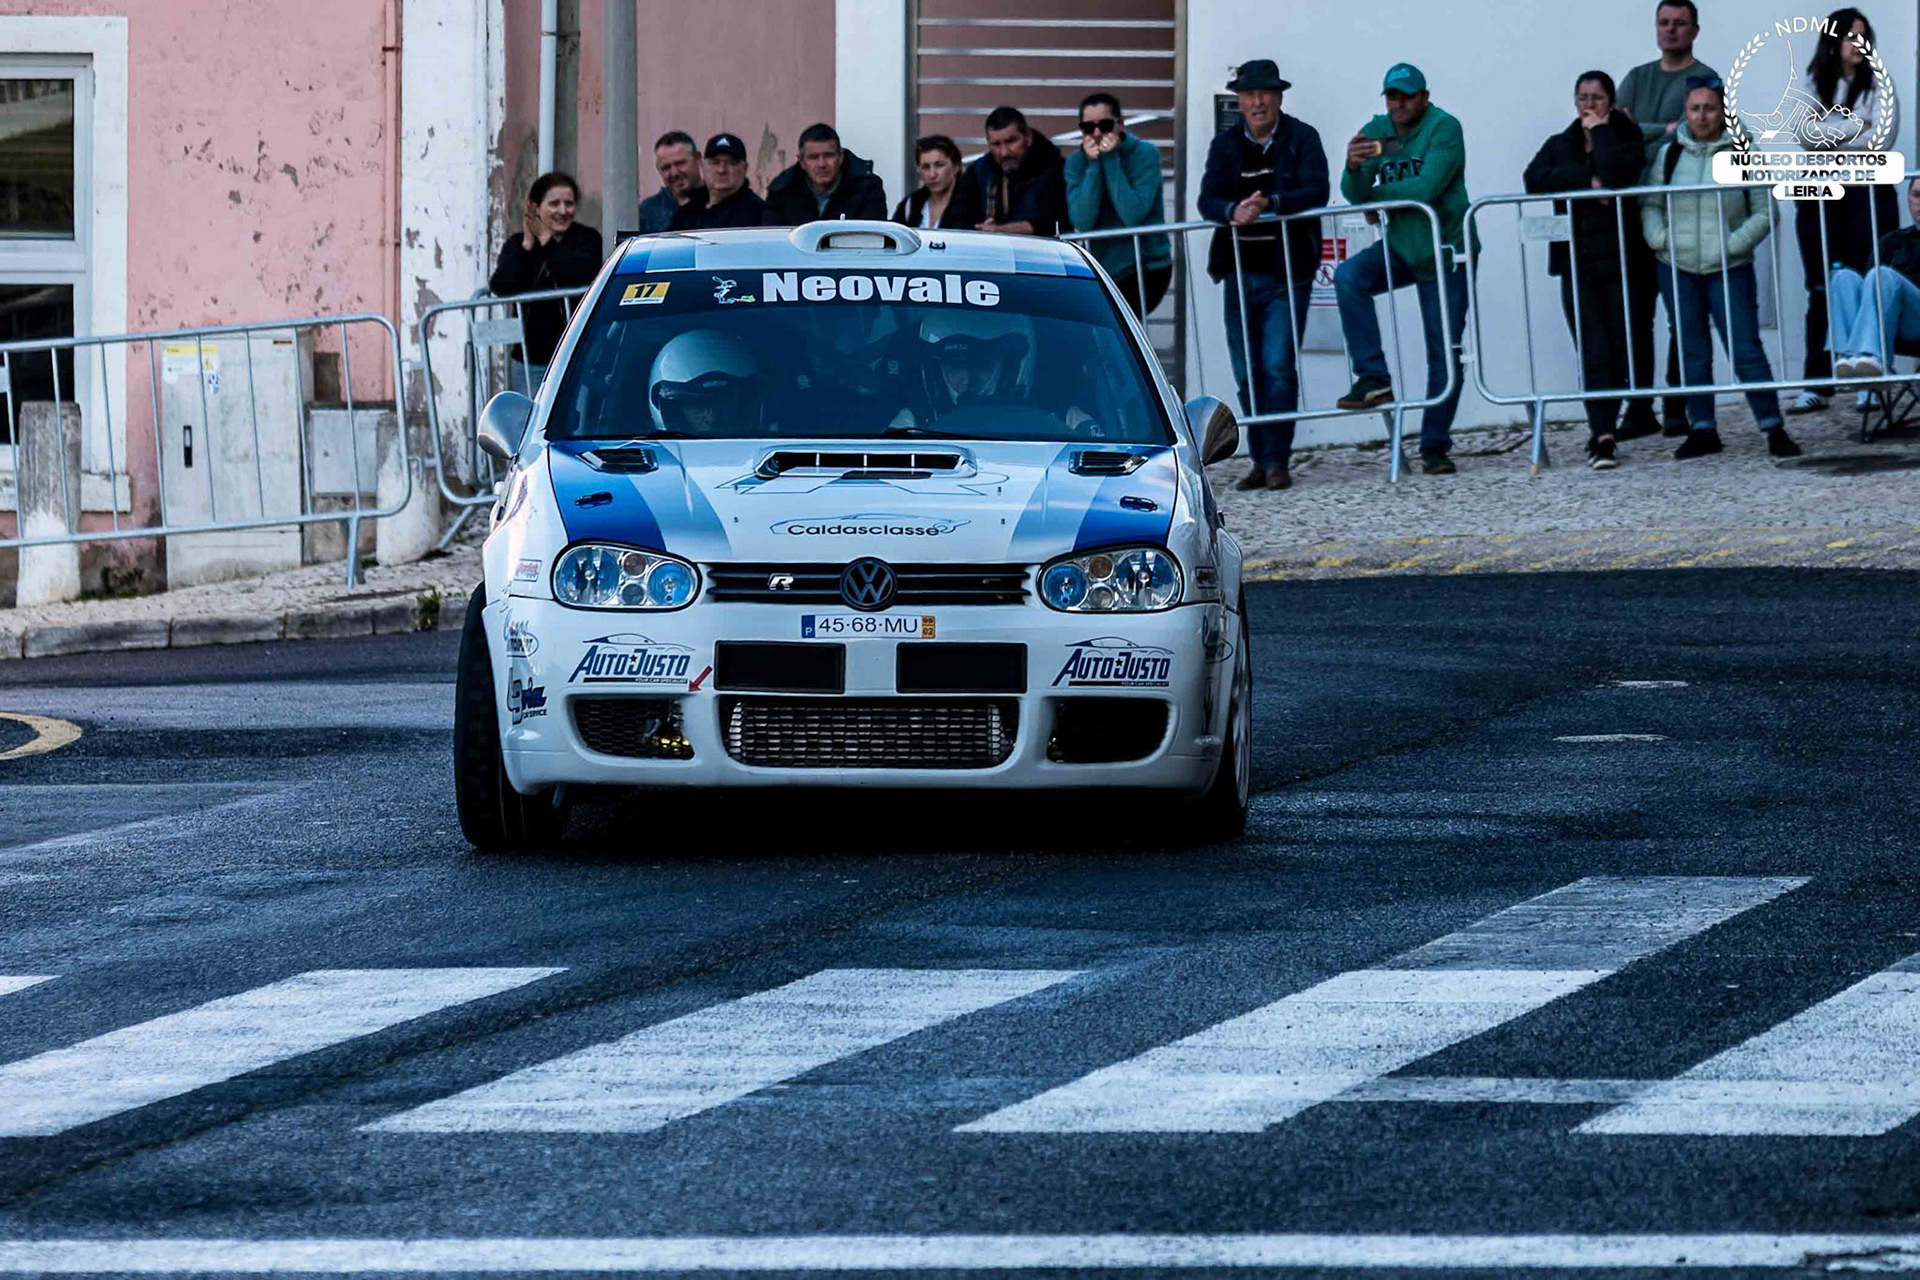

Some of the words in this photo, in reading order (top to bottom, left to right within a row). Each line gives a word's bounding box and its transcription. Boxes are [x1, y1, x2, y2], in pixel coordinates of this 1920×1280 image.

[634, 284, 658, 298] 17
[762, 272, 1000, 307] Neovale
[787, 524, 940, 536] Caldasclasse
[805, 627, 812, 636] P
